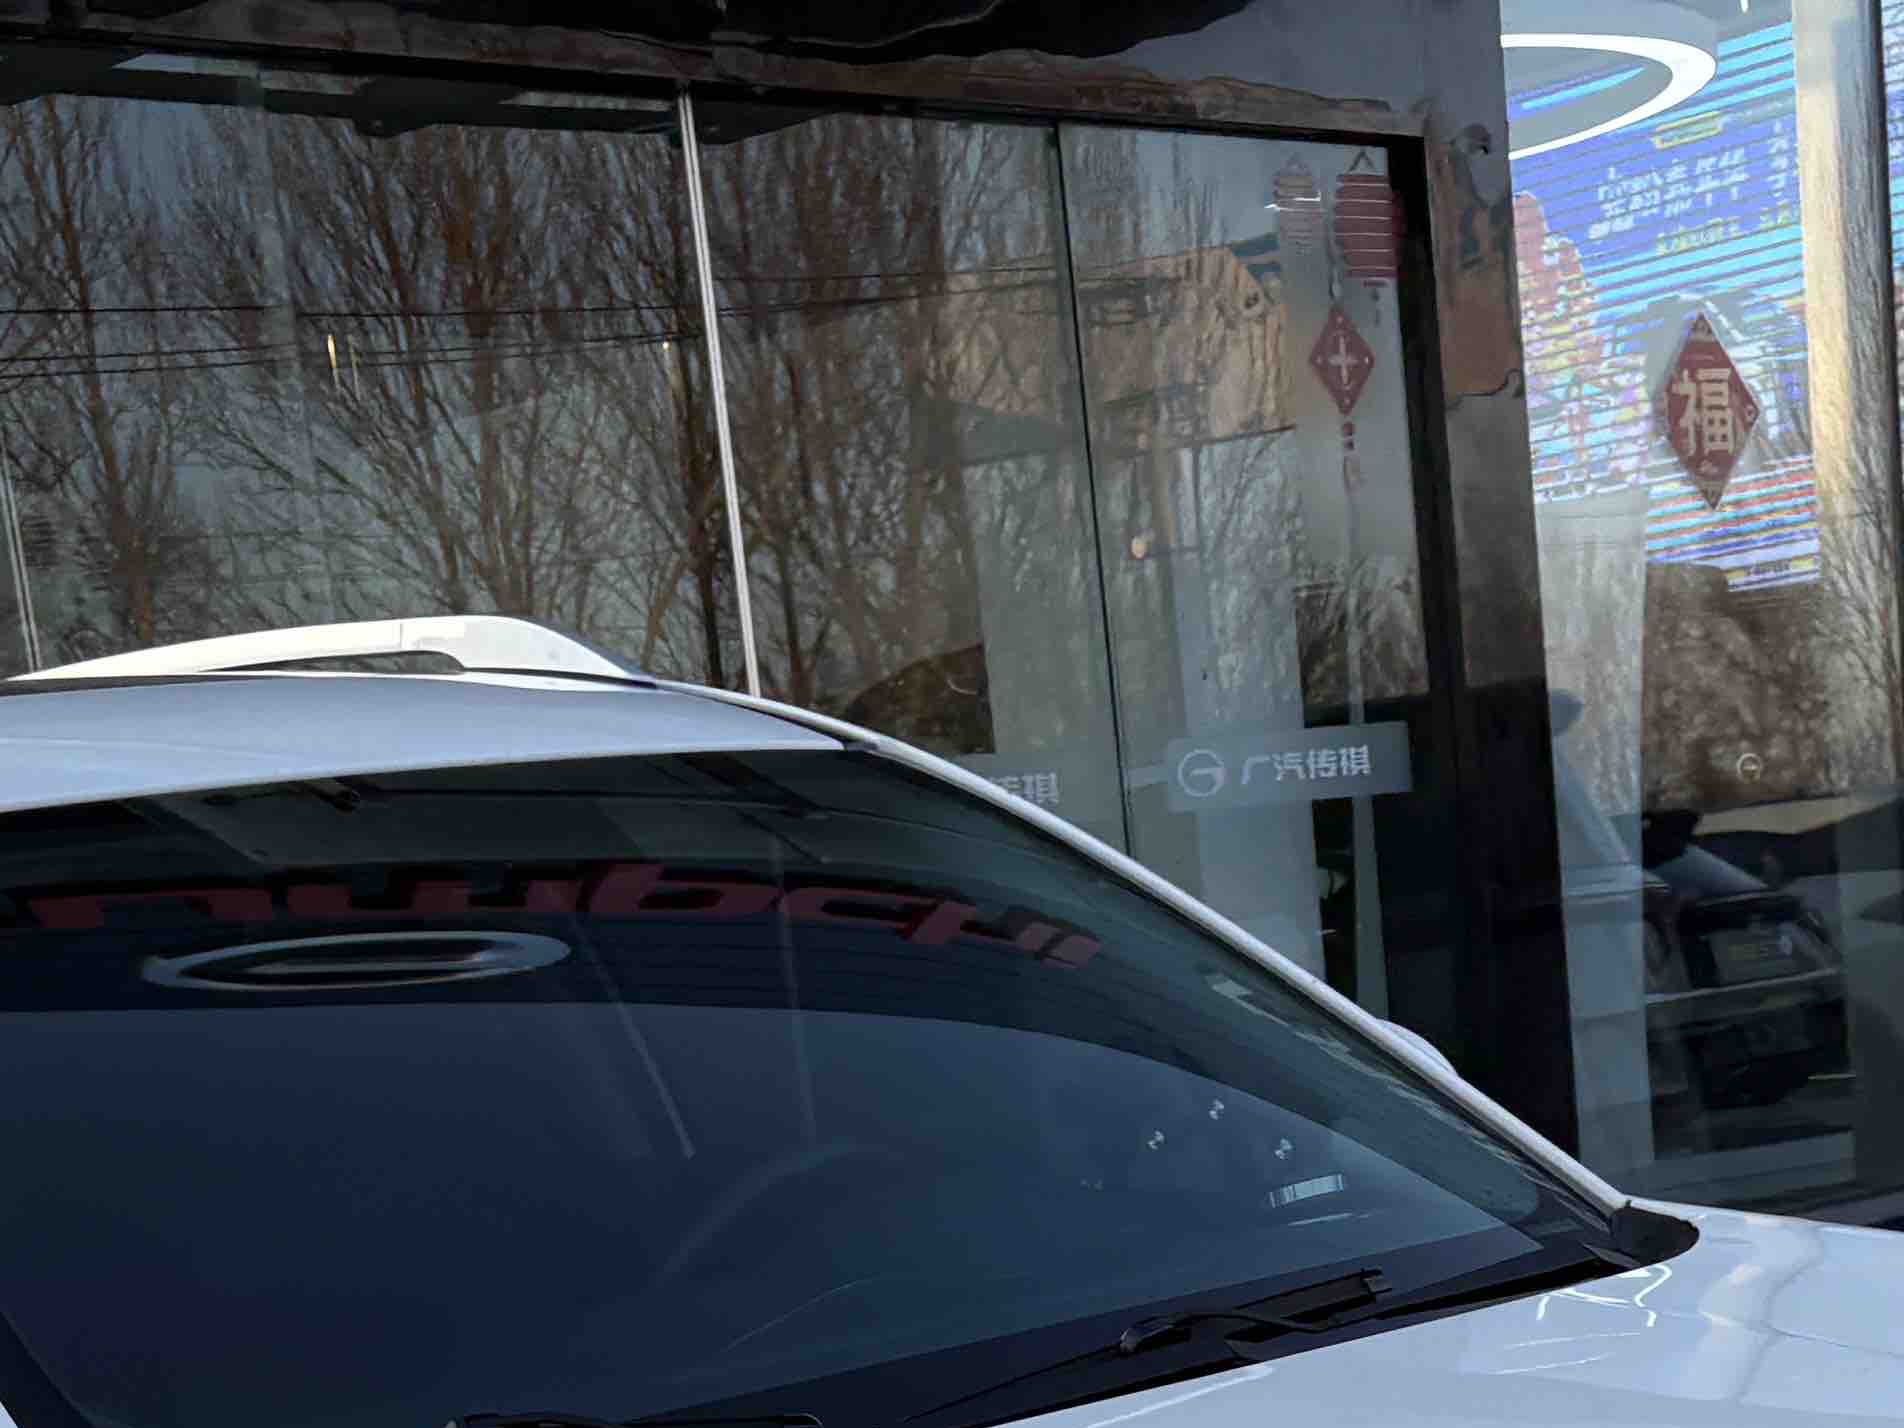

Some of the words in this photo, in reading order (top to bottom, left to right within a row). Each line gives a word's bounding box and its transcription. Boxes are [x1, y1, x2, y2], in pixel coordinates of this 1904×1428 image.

[1671, 366, 1737, 456] 福
[1241, 744, 1372, 786] 广汽传祺
